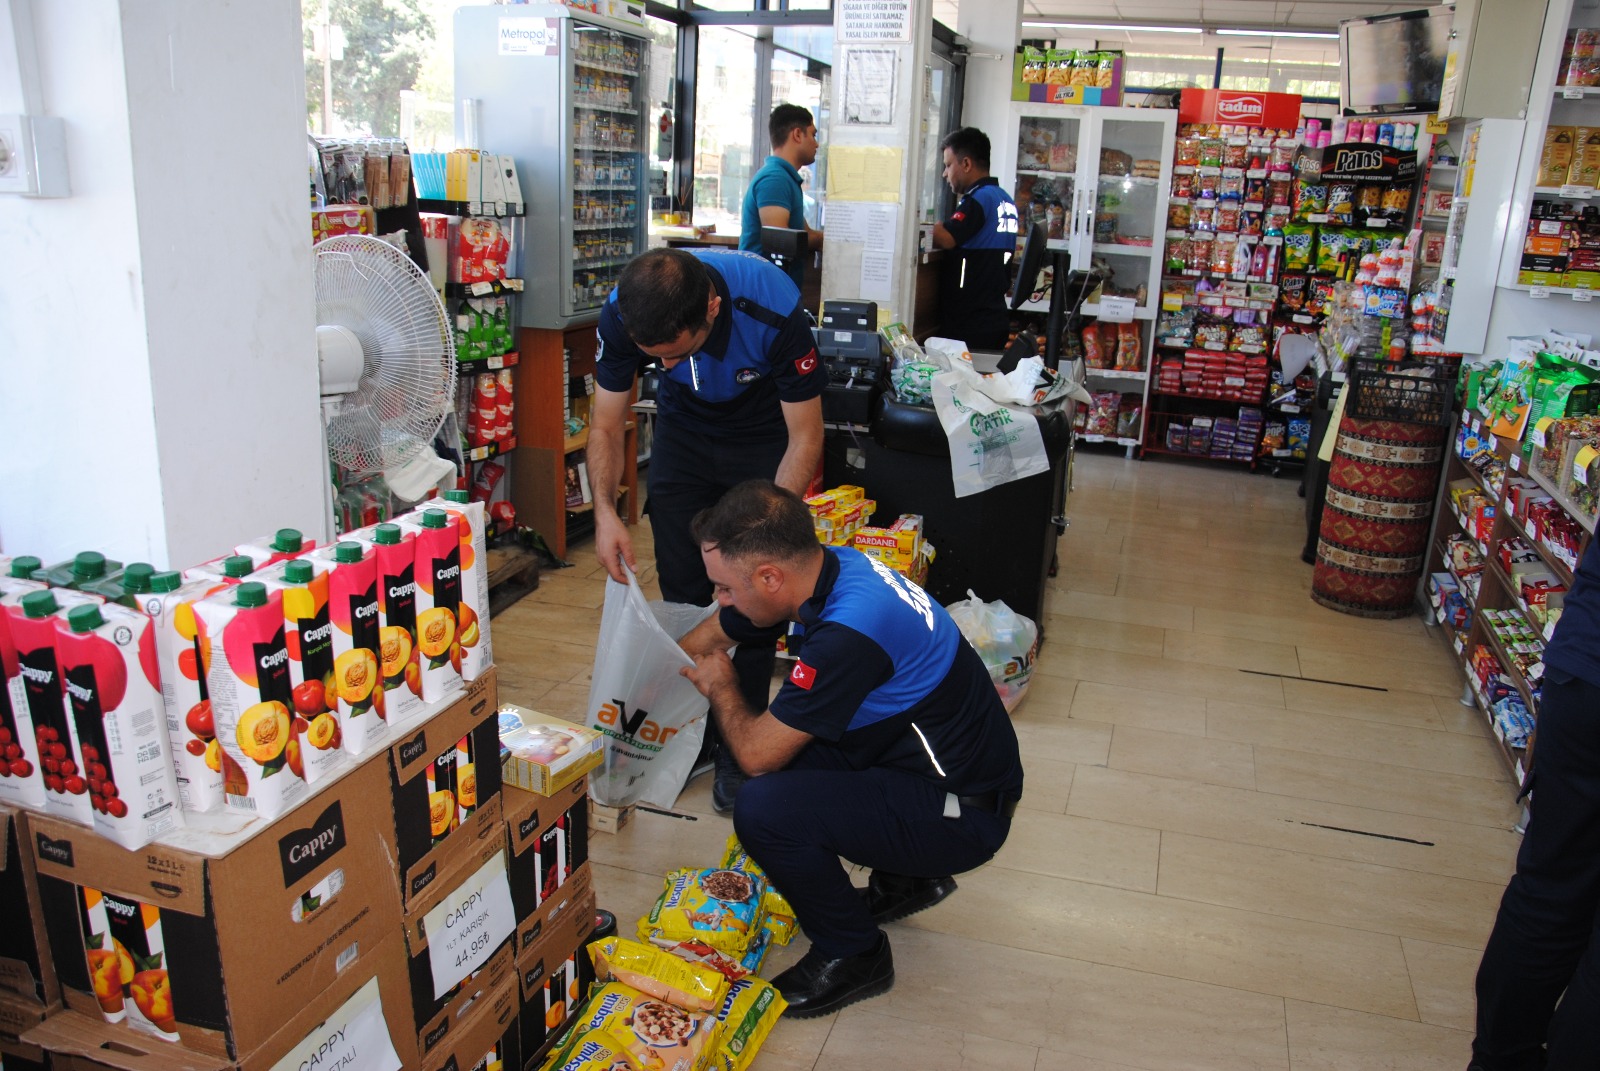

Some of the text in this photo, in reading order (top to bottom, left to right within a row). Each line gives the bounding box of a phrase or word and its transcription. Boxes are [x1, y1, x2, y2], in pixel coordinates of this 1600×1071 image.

[843, 3, 863, 11] SİGARA
[871, 2, 888, 11] DİĞER
[889, 2, 907, 11] TÜTÜN
[845, 12, 872, 20] ÜRÜNLERİ
[501, 28, 546, 41] Metropol
[863, 31, 879, 39] İŞLEM
[1218, 101, 1262, 114] tadım
[1398, 161, 1416, 171] CHIPS
[984, 414, 1014, 432] ATIK
[855, 536, 897, 548] DARDANEL
[437, 564, 459, 580] Cappy
[389, 581, 416, 599] Cappy
[355, 600, 379, 619] Cappy
[304, 623, 332, 643] Cappy
[260, 647, 289, 669] Cappy
[402, 740, 424, 759] Cappy
[521, 818, 538, 834] Cappy
[40, 840, 71, 860] Cappy
[288, 824, 337, 865] Cappy
[413, 869, 435, 889] Cappy
[103, 895, 136, 918] Cappy
[445, 886, 483, 929] CAPPY
[459, 908, 490, 941] KARIŞIK
[455, 930, 490, 968] 44,95₺
[527, 965, 543, 983] Cappy
[590, 993, 622, 1028] esquik
[615, 996, 632, 1011] DUO
[426, 1025, 448, 1045] Cappy
[559, 1041, 604, 1071] esquik
[593, 1049, 613, 1062] DUO
